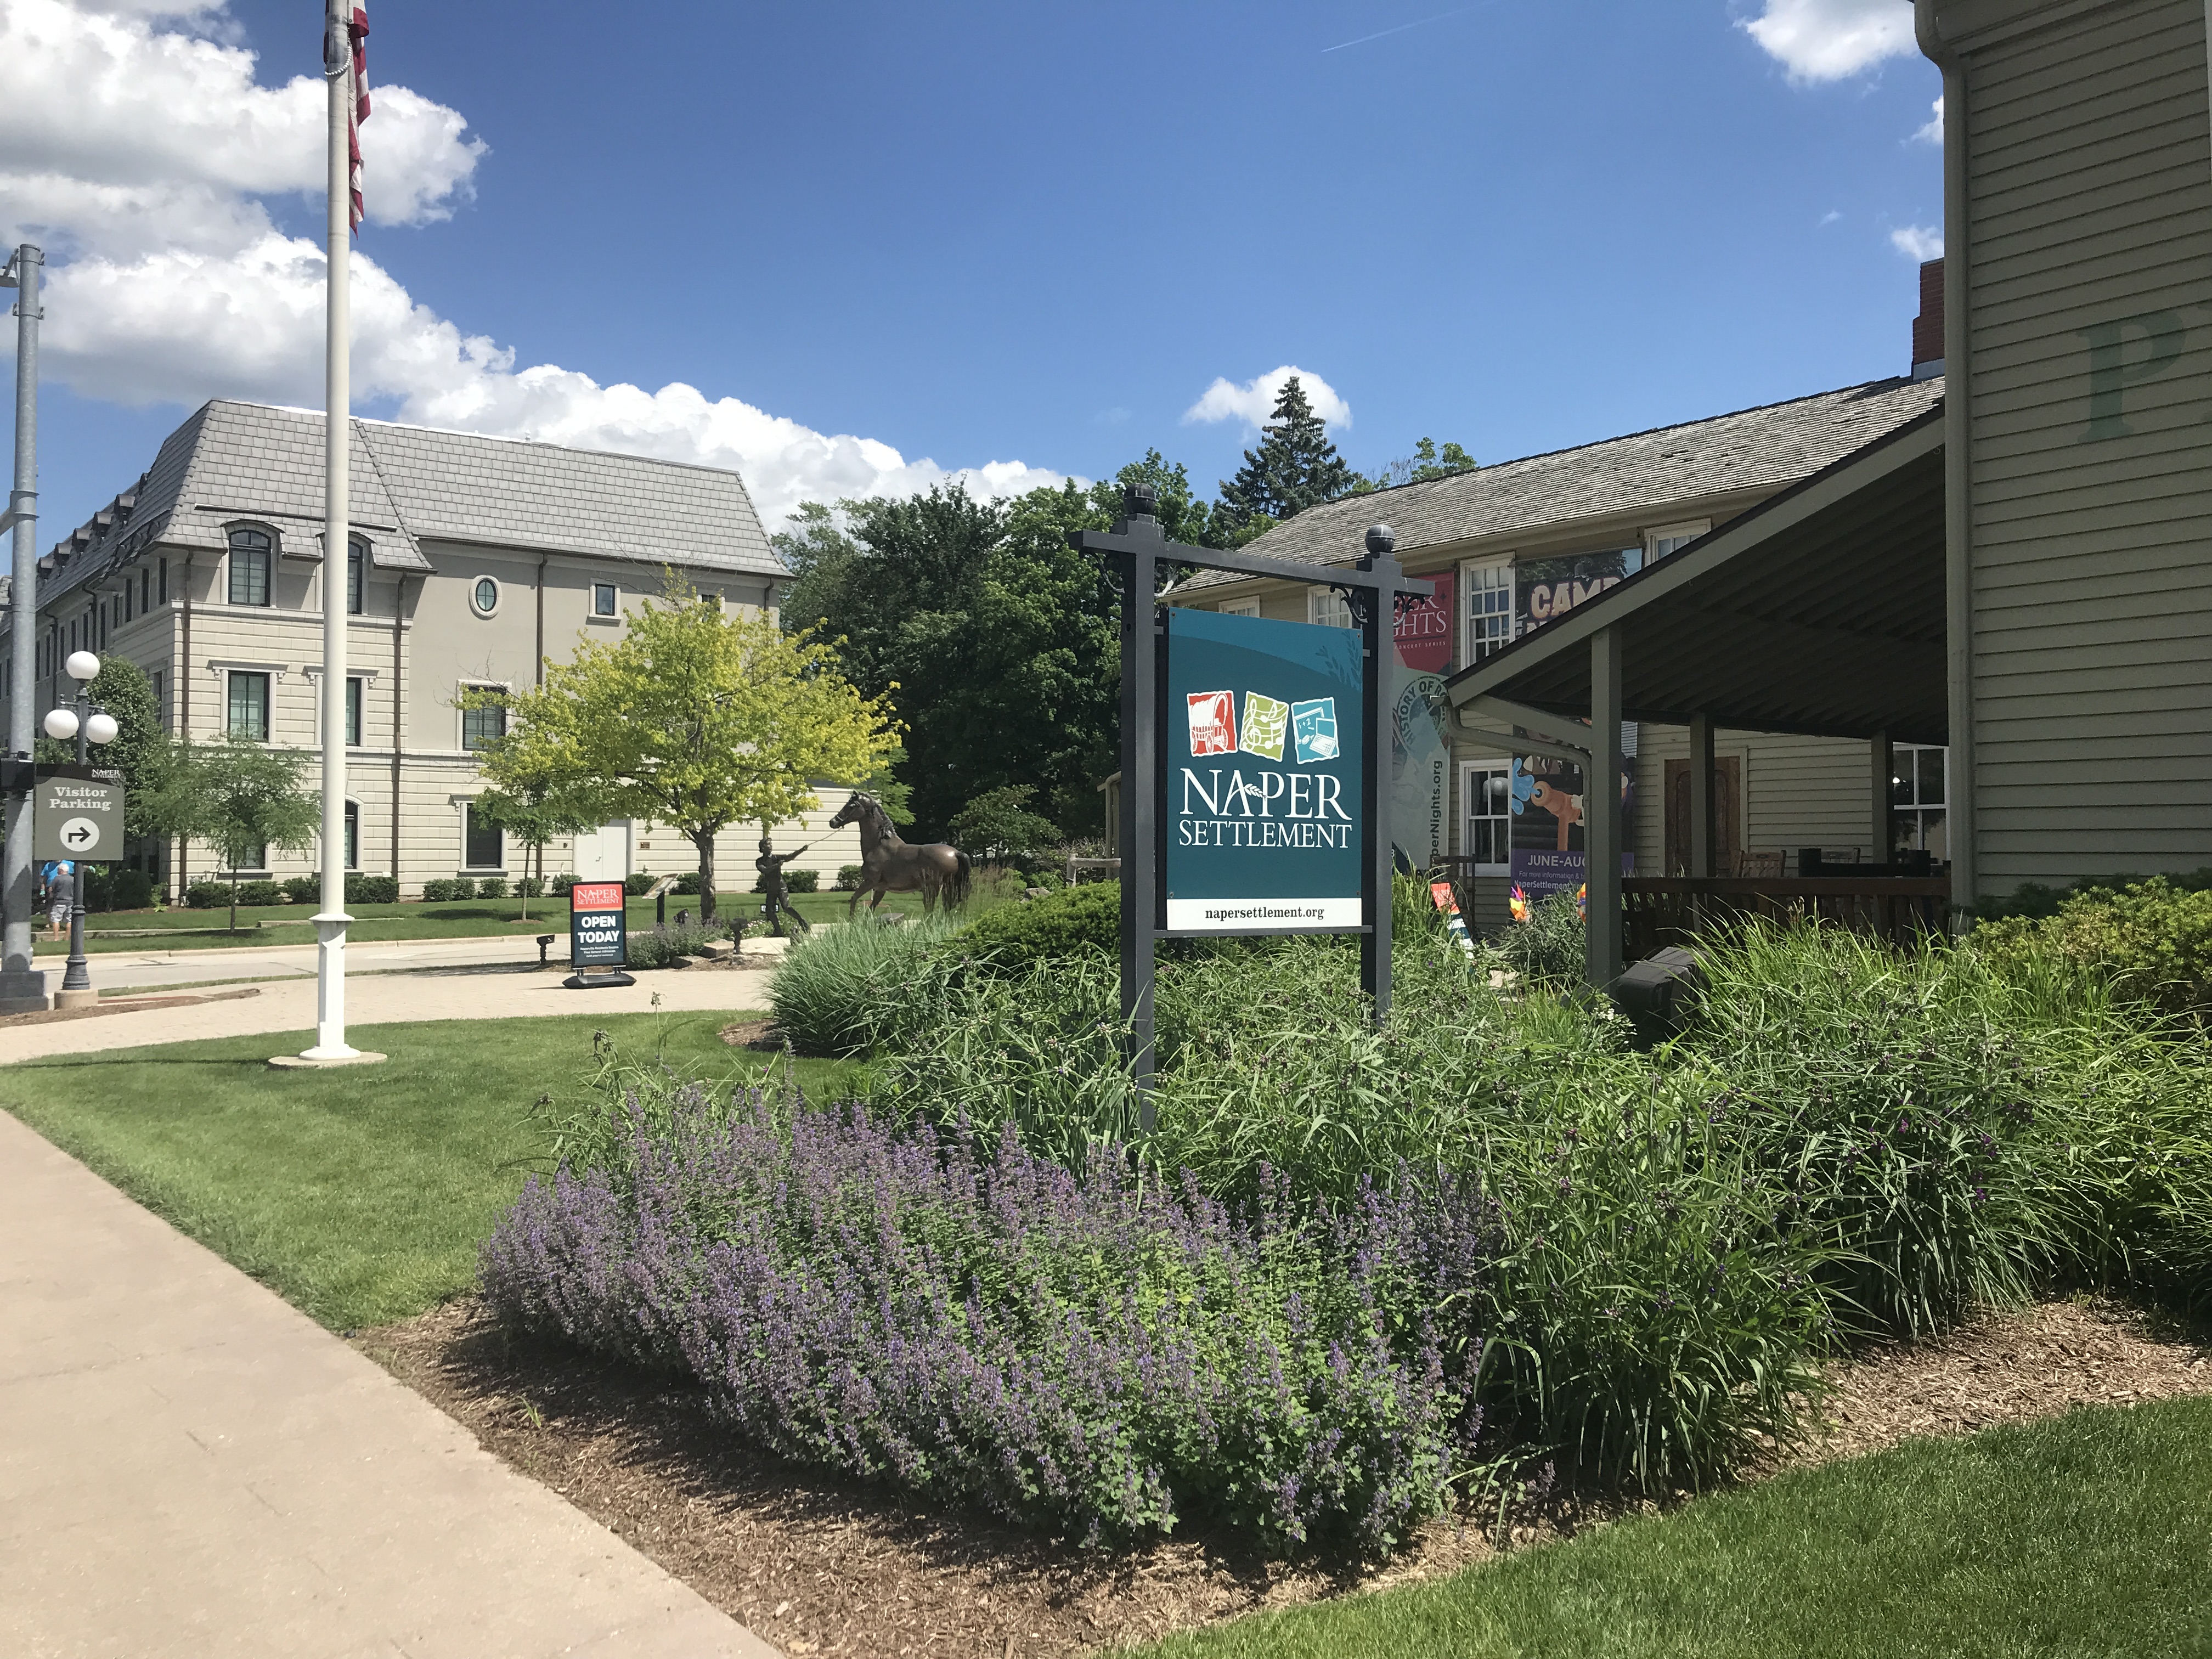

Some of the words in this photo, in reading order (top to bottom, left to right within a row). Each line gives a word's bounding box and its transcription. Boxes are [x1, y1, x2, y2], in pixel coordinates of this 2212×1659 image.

[1419, 680, 1435, 693] OF
[54, 787, 108, 797] Visitor
[1180, 768, 1352, 821] NAPER
[48, 798, 112, 811] Parking
[1179, 819, 1352, 849] SETTLEMENT
[1542, 871, 1574, 879] information
[577, 889, 619, 899] NAPER
[1205, 905, 1325, 921] napersettlement.org
[581, 916, 616, 928] OPEN
[577, 930, 620, 944] TODAY
